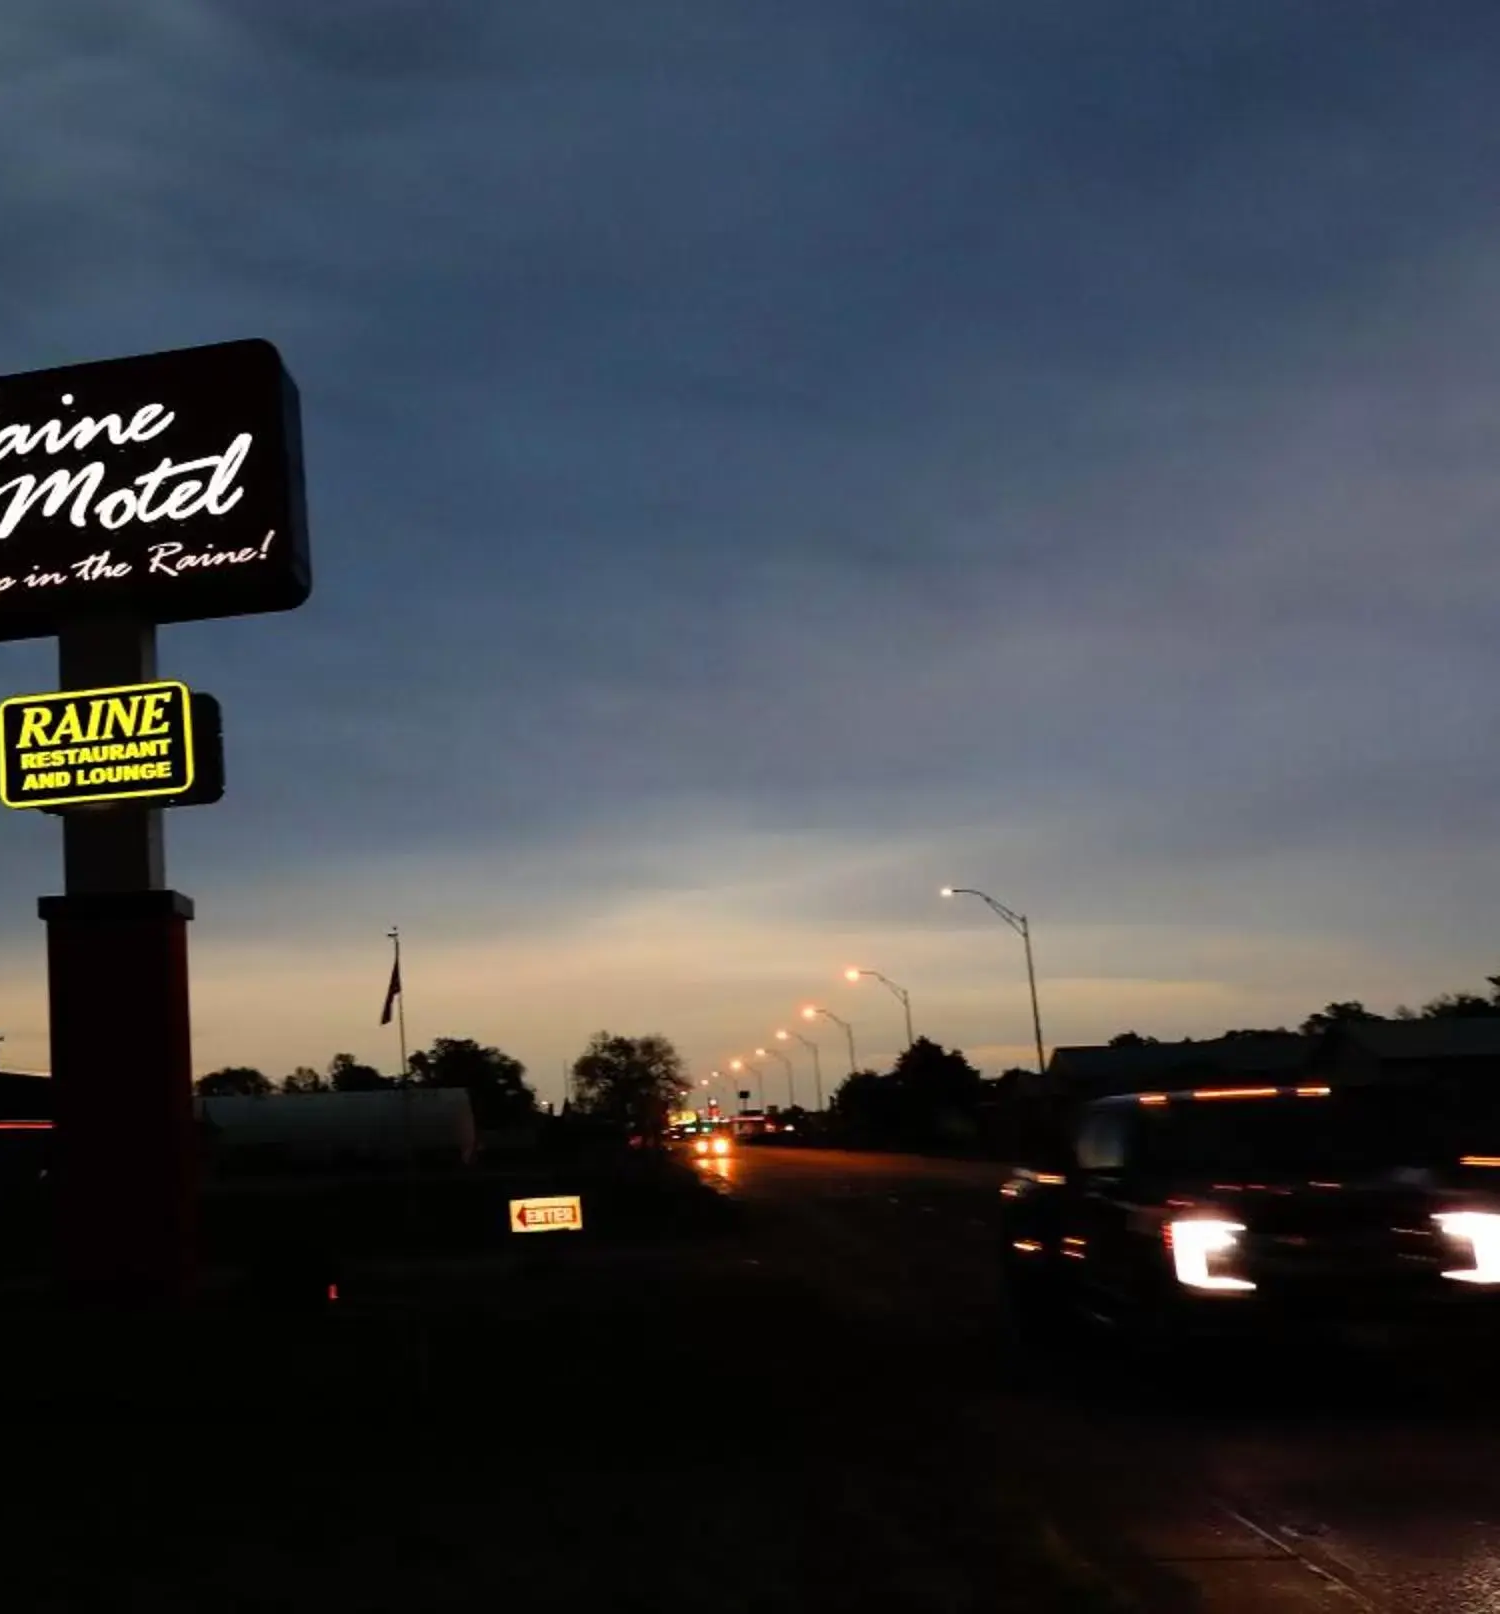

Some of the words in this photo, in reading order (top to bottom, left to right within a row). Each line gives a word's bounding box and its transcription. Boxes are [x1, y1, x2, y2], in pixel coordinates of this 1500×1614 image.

[22, 565, 69, 588] in
[70, 550, 133, 581] the
[147, 529, 275, 577] Raine!
[15, 691, 173, 749] RAINE
[20, 738, 173, 770] RESTAURANT
[21, 771, 72, 791] AND
[75, 760, 173, 786] LOUNGE
[526, 1207, 573, 1224] ENTER
